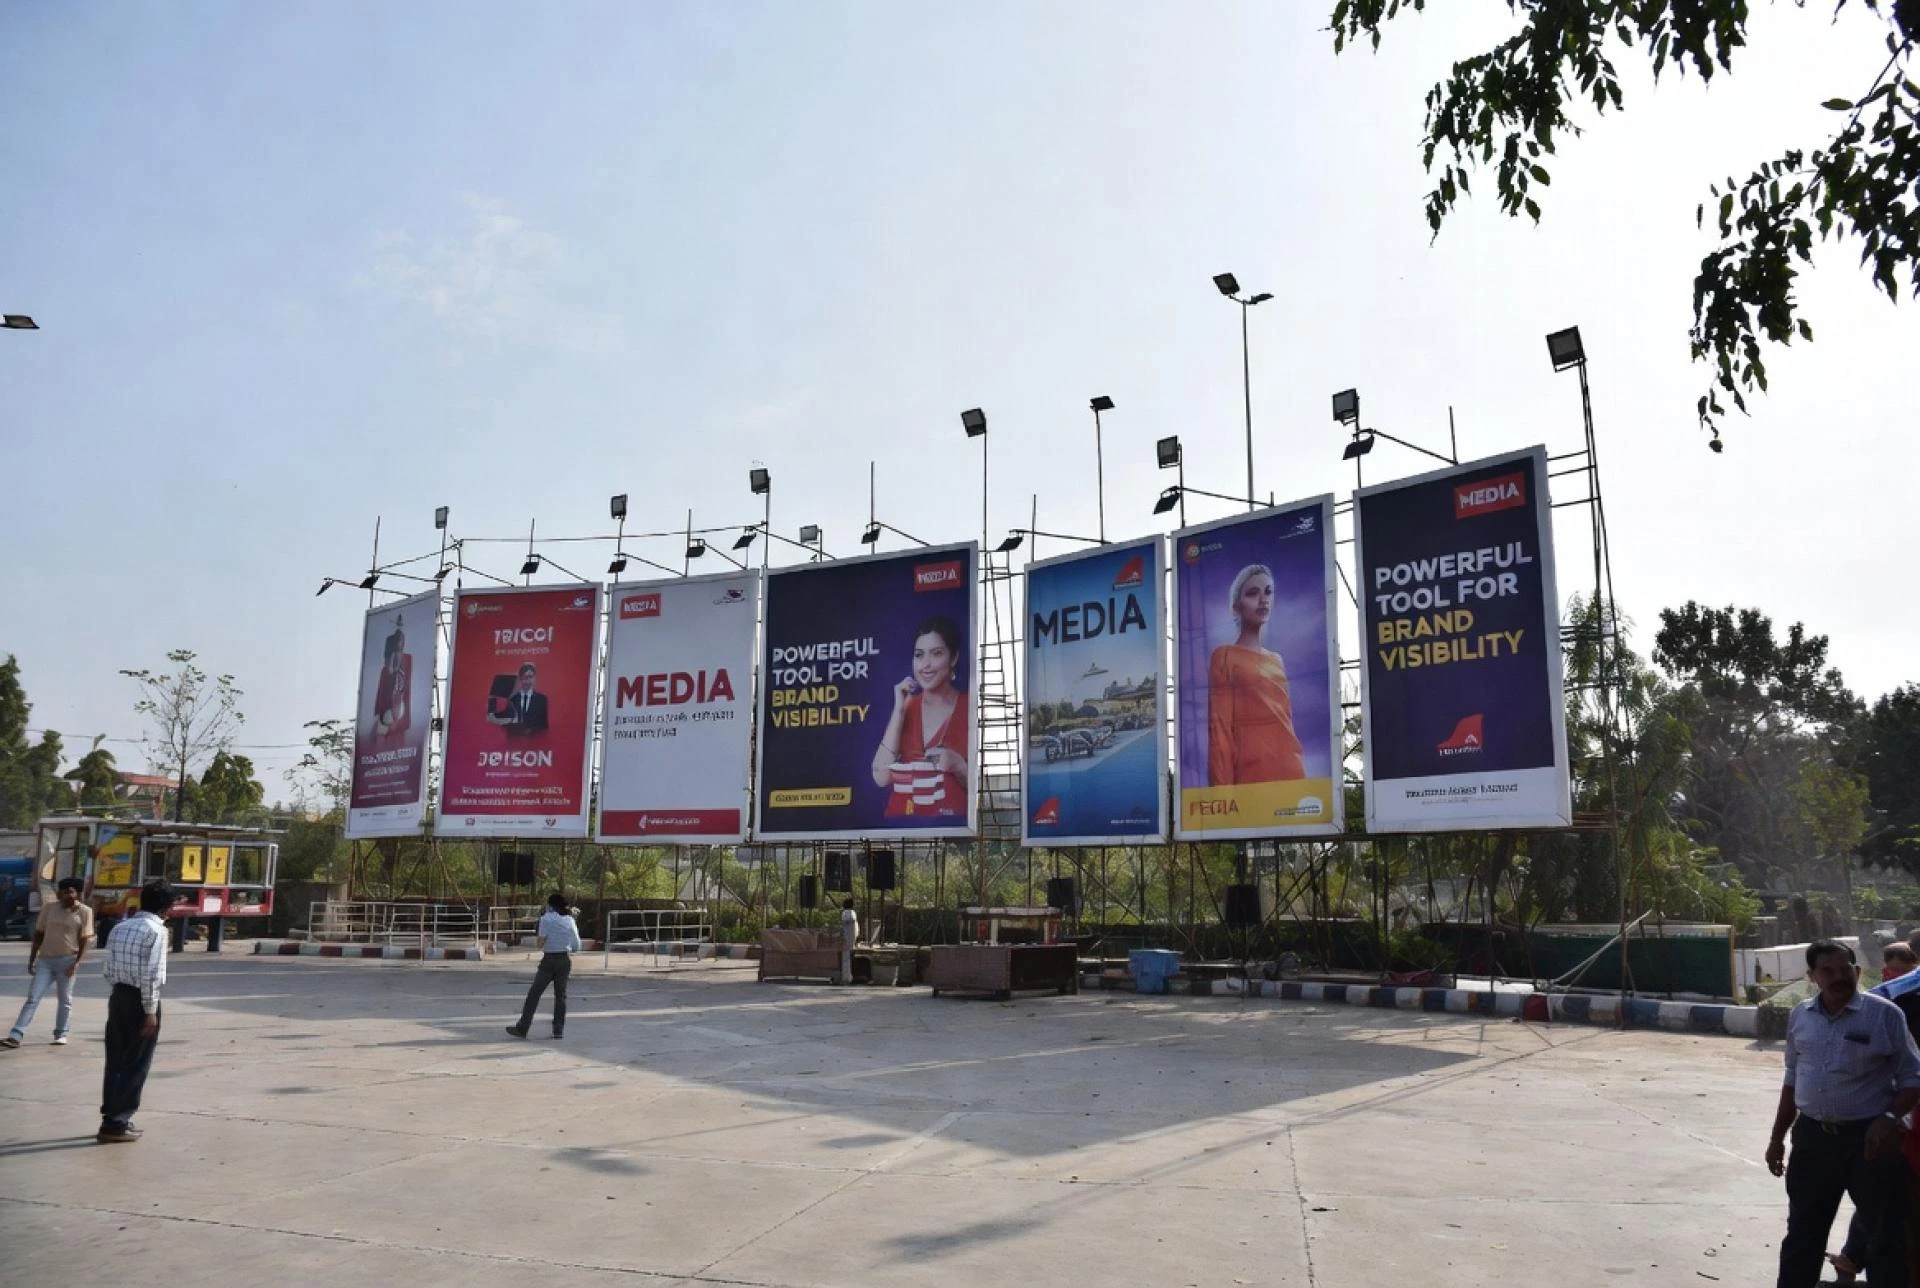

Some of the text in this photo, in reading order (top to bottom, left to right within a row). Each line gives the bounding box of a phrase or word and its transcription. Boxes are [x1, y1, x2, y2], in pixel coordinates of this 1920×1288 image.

[1459, 482, 1520, 509] MEDIA
[1375, 541, 1532, 589] POWERFUL
[1375, 572, 1519, 616] TOOL FOR
[1033, 593, 1147, 648] MEDIA
[1377, 609, 1474, 644] BRAND
[1379, 629, 1524, 672] VISIBILITY
[616, 668, 736, 709] MEDIA
[772, 661, 869, 686] TOOL FOR
[772, 685, 839, 708] BRAND
[772, 704, 870, 729] VISIBILITY
